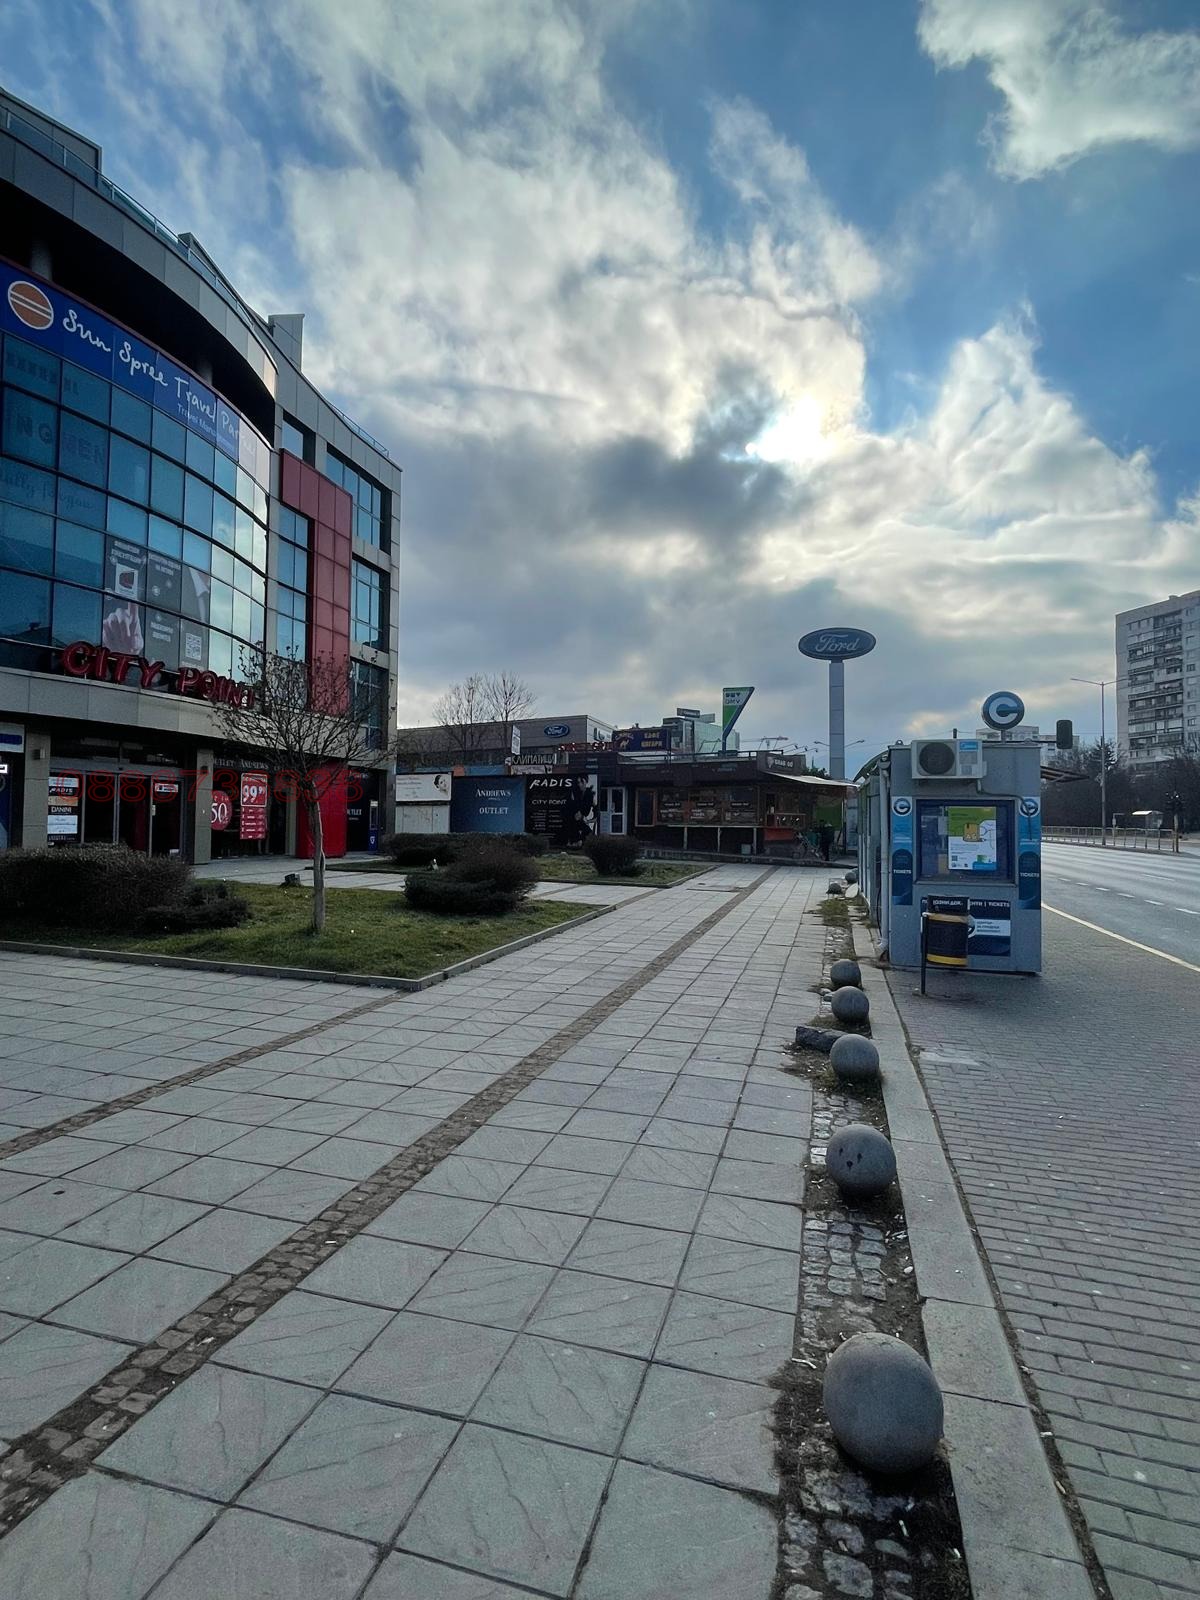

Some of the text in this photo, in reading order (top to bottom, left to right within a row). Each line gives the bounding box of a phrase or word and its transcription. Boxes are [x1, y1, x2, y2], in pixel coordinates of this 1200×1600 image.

[63, 309, 111, 352] Sun
[119, 341, 168, 386] Spree
[174, 376, 217, 422] Travel
[815, 634, 860, 652] Ford
[62, 641, 164, 688] CITY
[547, 726, 564, 735] Ford
[530, 778, 573, 790] RADIS
[479, 806, 509, 815] OUTLET
